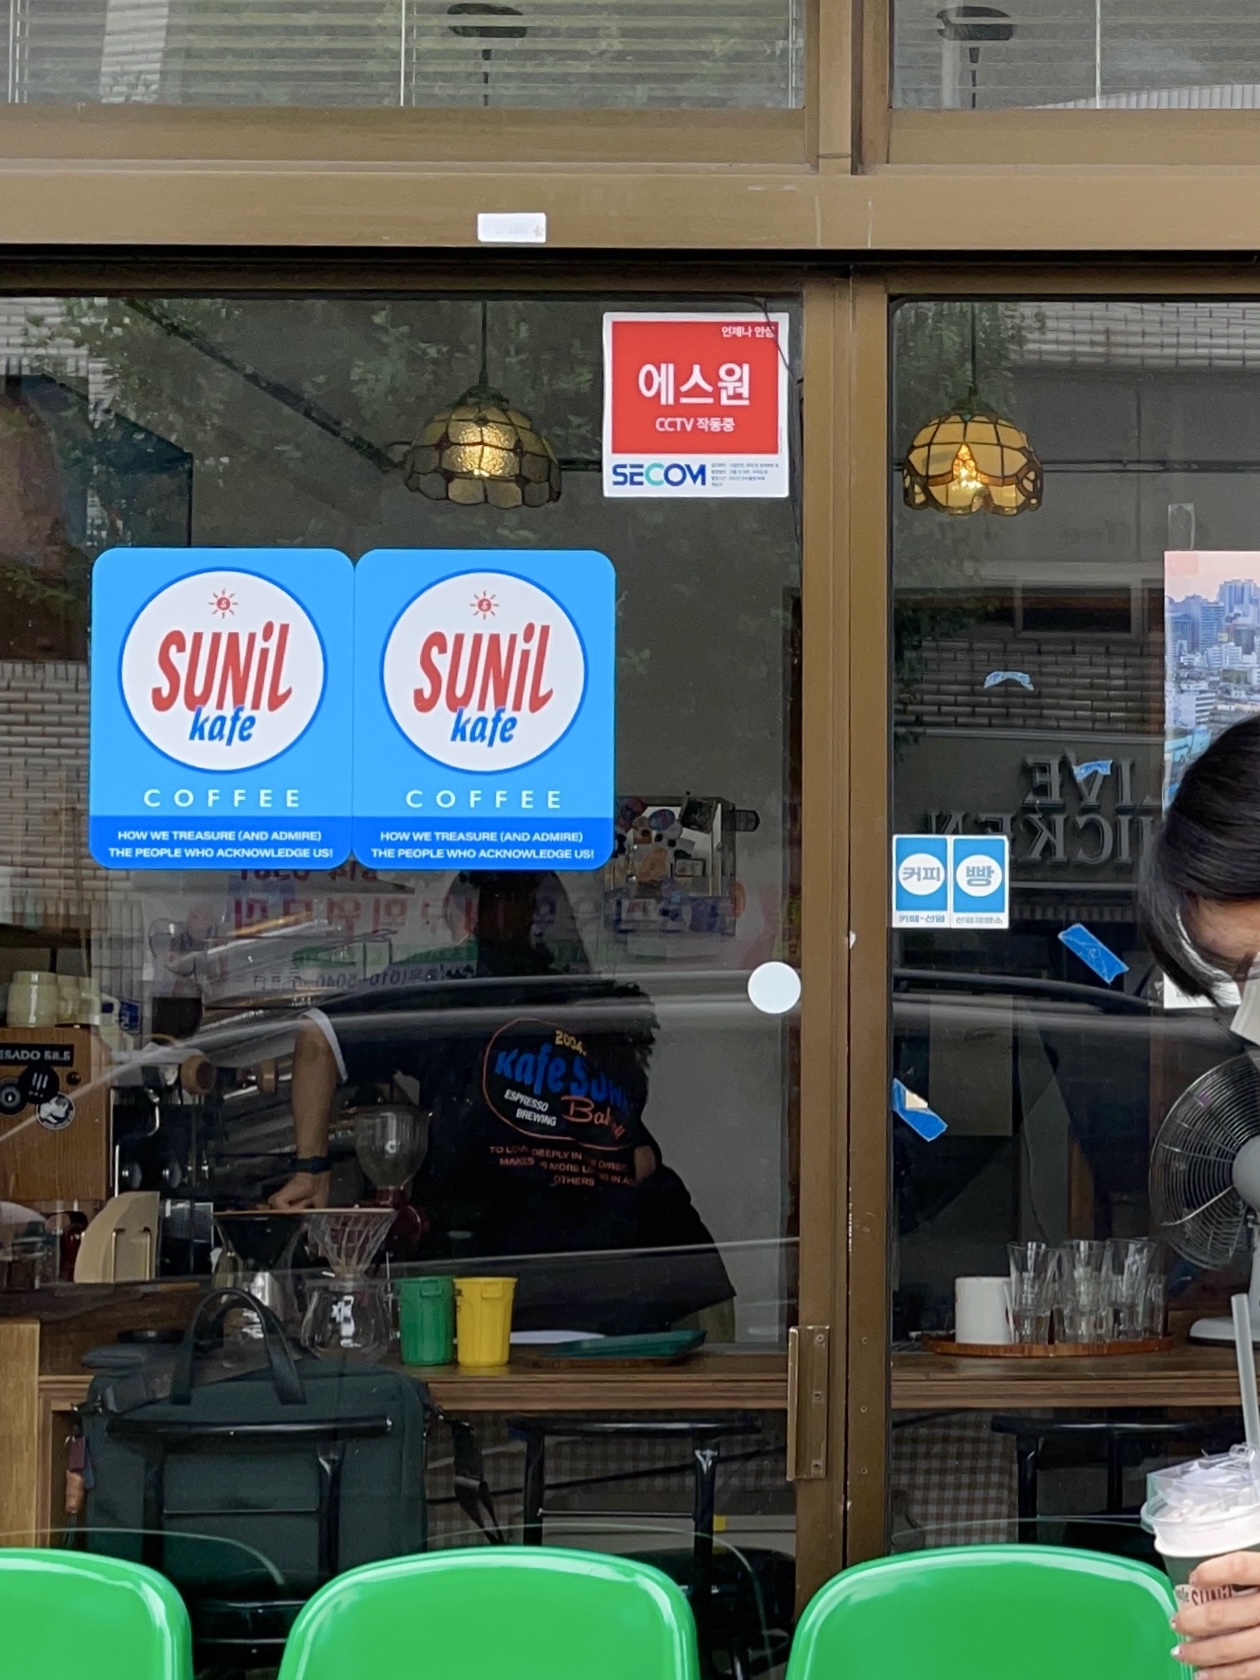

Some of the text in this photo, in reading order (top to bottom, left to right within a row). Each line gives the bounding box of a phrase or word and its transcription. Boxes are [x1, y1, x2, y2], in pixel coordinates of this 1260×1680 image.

[721, 326, 753, 338] 언제나
[638, 362, 750, 406] 에스원
[655, 417, 736, 432] CCTV 작동중
[612, 462, 706, 487] SECOM
[188, 704, 256, 747] kafe
[449, 706, 518, 748] kafe
[143, 788, 300, 808] COFFEE
[405, 789, 561, 809] COFFEE
[118, 830, 322, 842] HOW WE TREASURE (AND ADMIRE)
[380, 831, 583, 843] HOW WE TREASURE (AND ADMIRE)
[109, 847, 334, 859] THE PEOPLE WHO ACKNOWLEDGE US!
[371, 848, 594, 860] THE PEOPLE WHO ACKNOWLEDGE US!
[902, 866, 941, 882] 커피
[965, 865, 995, 887] 빵
[503, 1088, 549, 1112] ESPRESSO
[515, 1108, 557, 1127] BREWING
